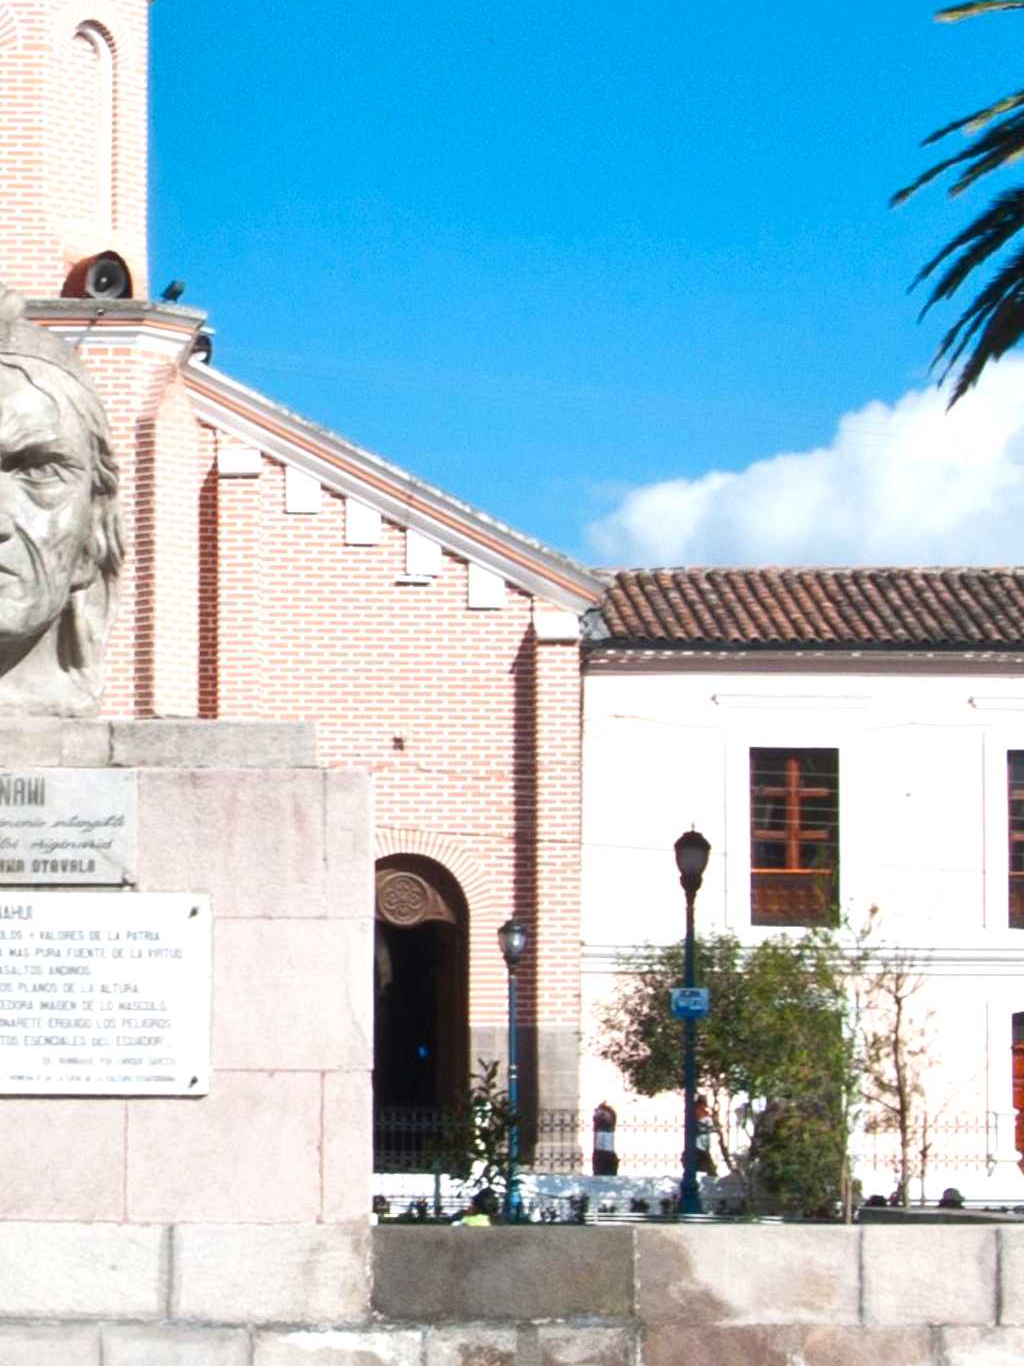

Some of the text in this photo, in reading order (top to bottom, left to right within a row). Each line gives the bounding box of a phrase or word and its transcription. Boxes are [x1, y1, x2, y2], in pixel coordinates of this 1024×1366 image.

[31, 859, 96, 873] OTAVALO
[39, 930, 85, 941] VALORES
[89, 930, 102, 941] DE
[107, 930, 120, 941] LA
[126, 930, 160, 941] PATRIA
[9, 947, 29, 957] MAS
[35, 947, 61, 958] PURA
[66, 947, 106, 958] FUENTE
[112, 947, 124, 959] DE
[130, 947, 143, 959] LA
[148, 947, 184, 959] VIRTUD
[49, 965, 91, 976] ANDINOS
[18, 982, 58, 993] PLANOS
[63, 982, 75, 993] DE
[81, 983, 94, 993] LA
[101, 983, 139, 994] ALTURA
[82, 1000, 94, 1011] DE
[96, 1018, 116, 1029] LOS
[121, 1018, 172, 1029] PELIGROS
